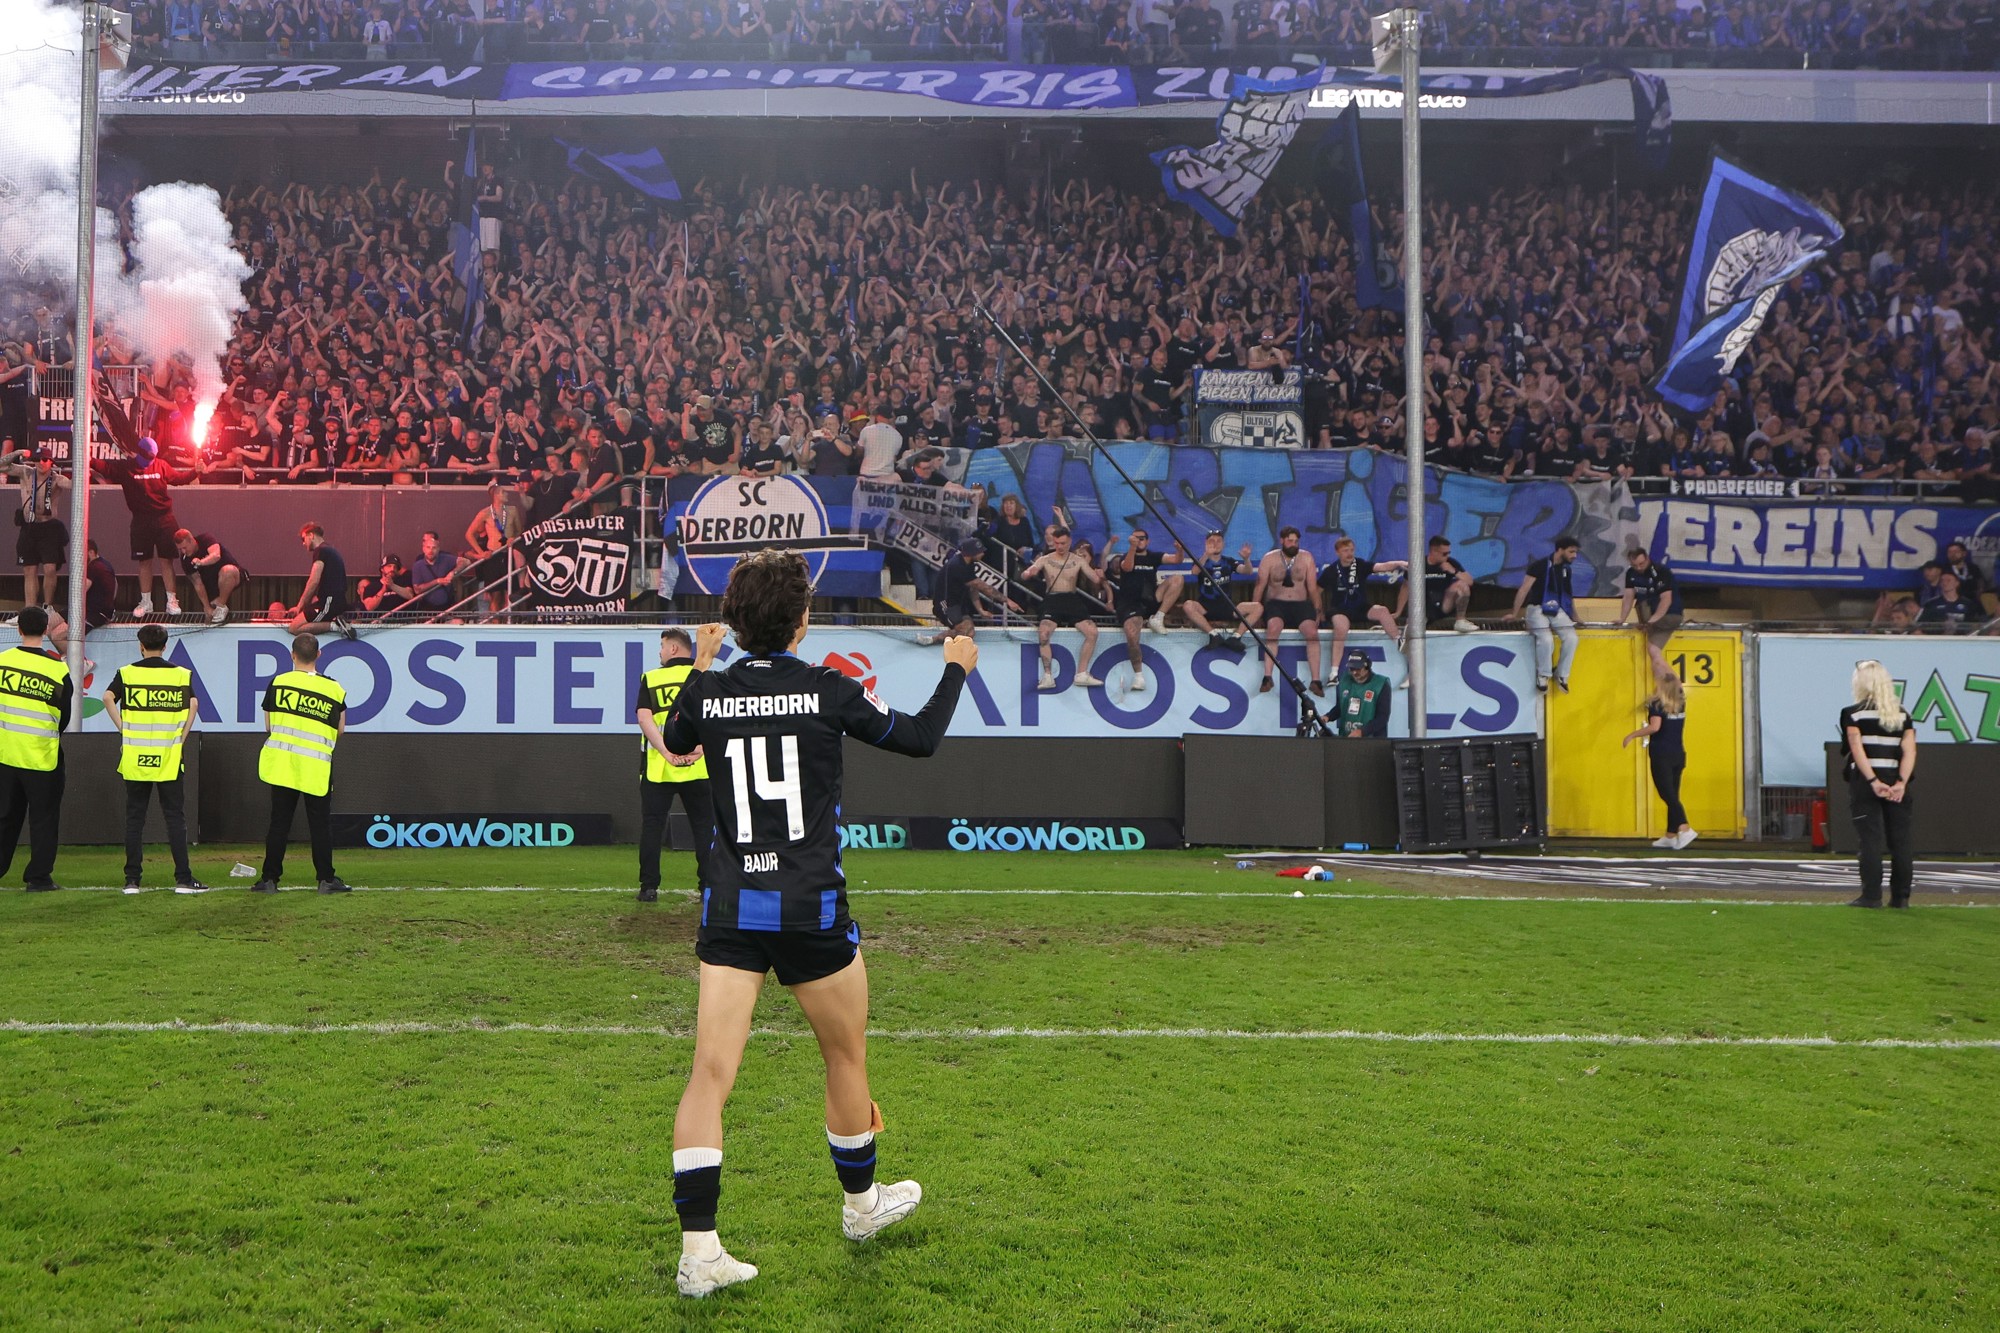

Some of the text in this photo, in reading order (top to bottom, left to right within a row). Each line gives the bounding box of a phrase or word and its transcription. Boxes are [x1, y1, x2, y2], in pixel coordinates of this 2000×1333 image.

[340, 65, 482, 87] AN
[971, 68, 1122, 106] BIS
[1246, 415, 1273, 427] ULTRAS
[739, 480, 767, 507] SC
[1684, 479, 1785, 496] PADERFEUER
[867, 495, 895, 508] UND
[899, 498, 937, 516] ALLES
[900, 521, 925, 549] PB
[1672, 653, 1715, 685] 13
[20, 675, 55, 696] KONE
[167, 638, 734, 727] APOSTEL
[149, 690, 183, 702] KONE
[299, 694, 333, 714] KONE
[702, 693, 819, 719] PADERBORN
[138, 756, 161, 767] 224
[724, 735, 805, 844] 14
[366, 814, 575, 848] ÖKOWORLD
[947, 818, 1146, 851] ÖKOWORLD
[743, 852, 778, 873] BAUR
